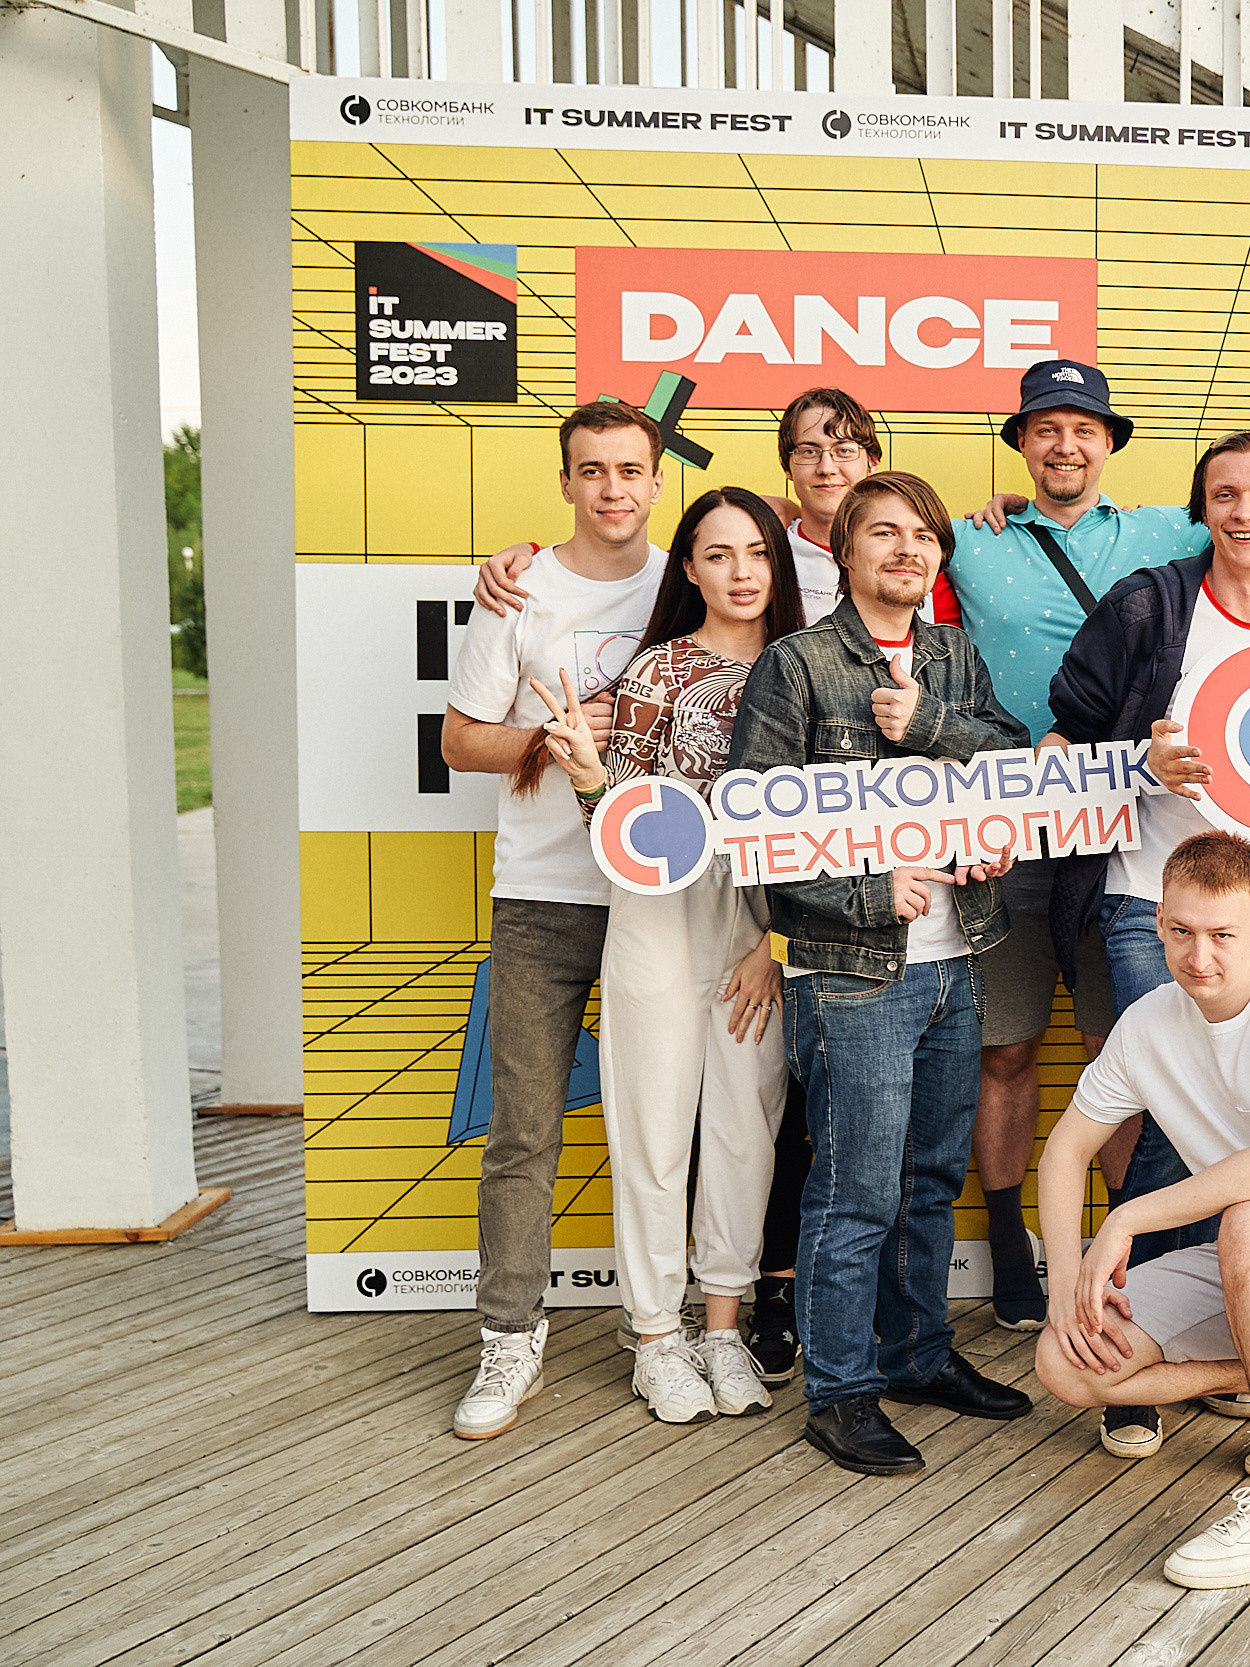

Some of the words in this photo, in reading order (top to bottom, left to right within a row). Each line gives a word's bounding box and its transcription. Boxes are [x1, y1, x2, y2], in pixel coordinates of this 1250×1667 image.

[377, 98, 494, 116] СОВКОМБАНК
[377, 114, 465, 126] ТЕХНОЛОГИИ
[524, 107, 553, 125] IT
[561, 108, 702, 130] SUMMER
[710, 113, 792, 133] FEST
[857, 113, 970, 131] СОВКОМБАНК
[857, 128, 942, 140] ТЕХНОЛОГИИ
[999, 121, 1028, 139] IT
[1035, 122, 1170, 144] SUMMER
[368, 318, 507, 341] SUMMER
[621, 291, 1059, 369] DANCE
[369, 342, 452, 363] FEST
[369, 364, 459, 386] 2023
[720, 743, 1160, 821] СОВКОМБАНК
[723, 803, 1134, 878] ТЕХНОЛОГИИ
